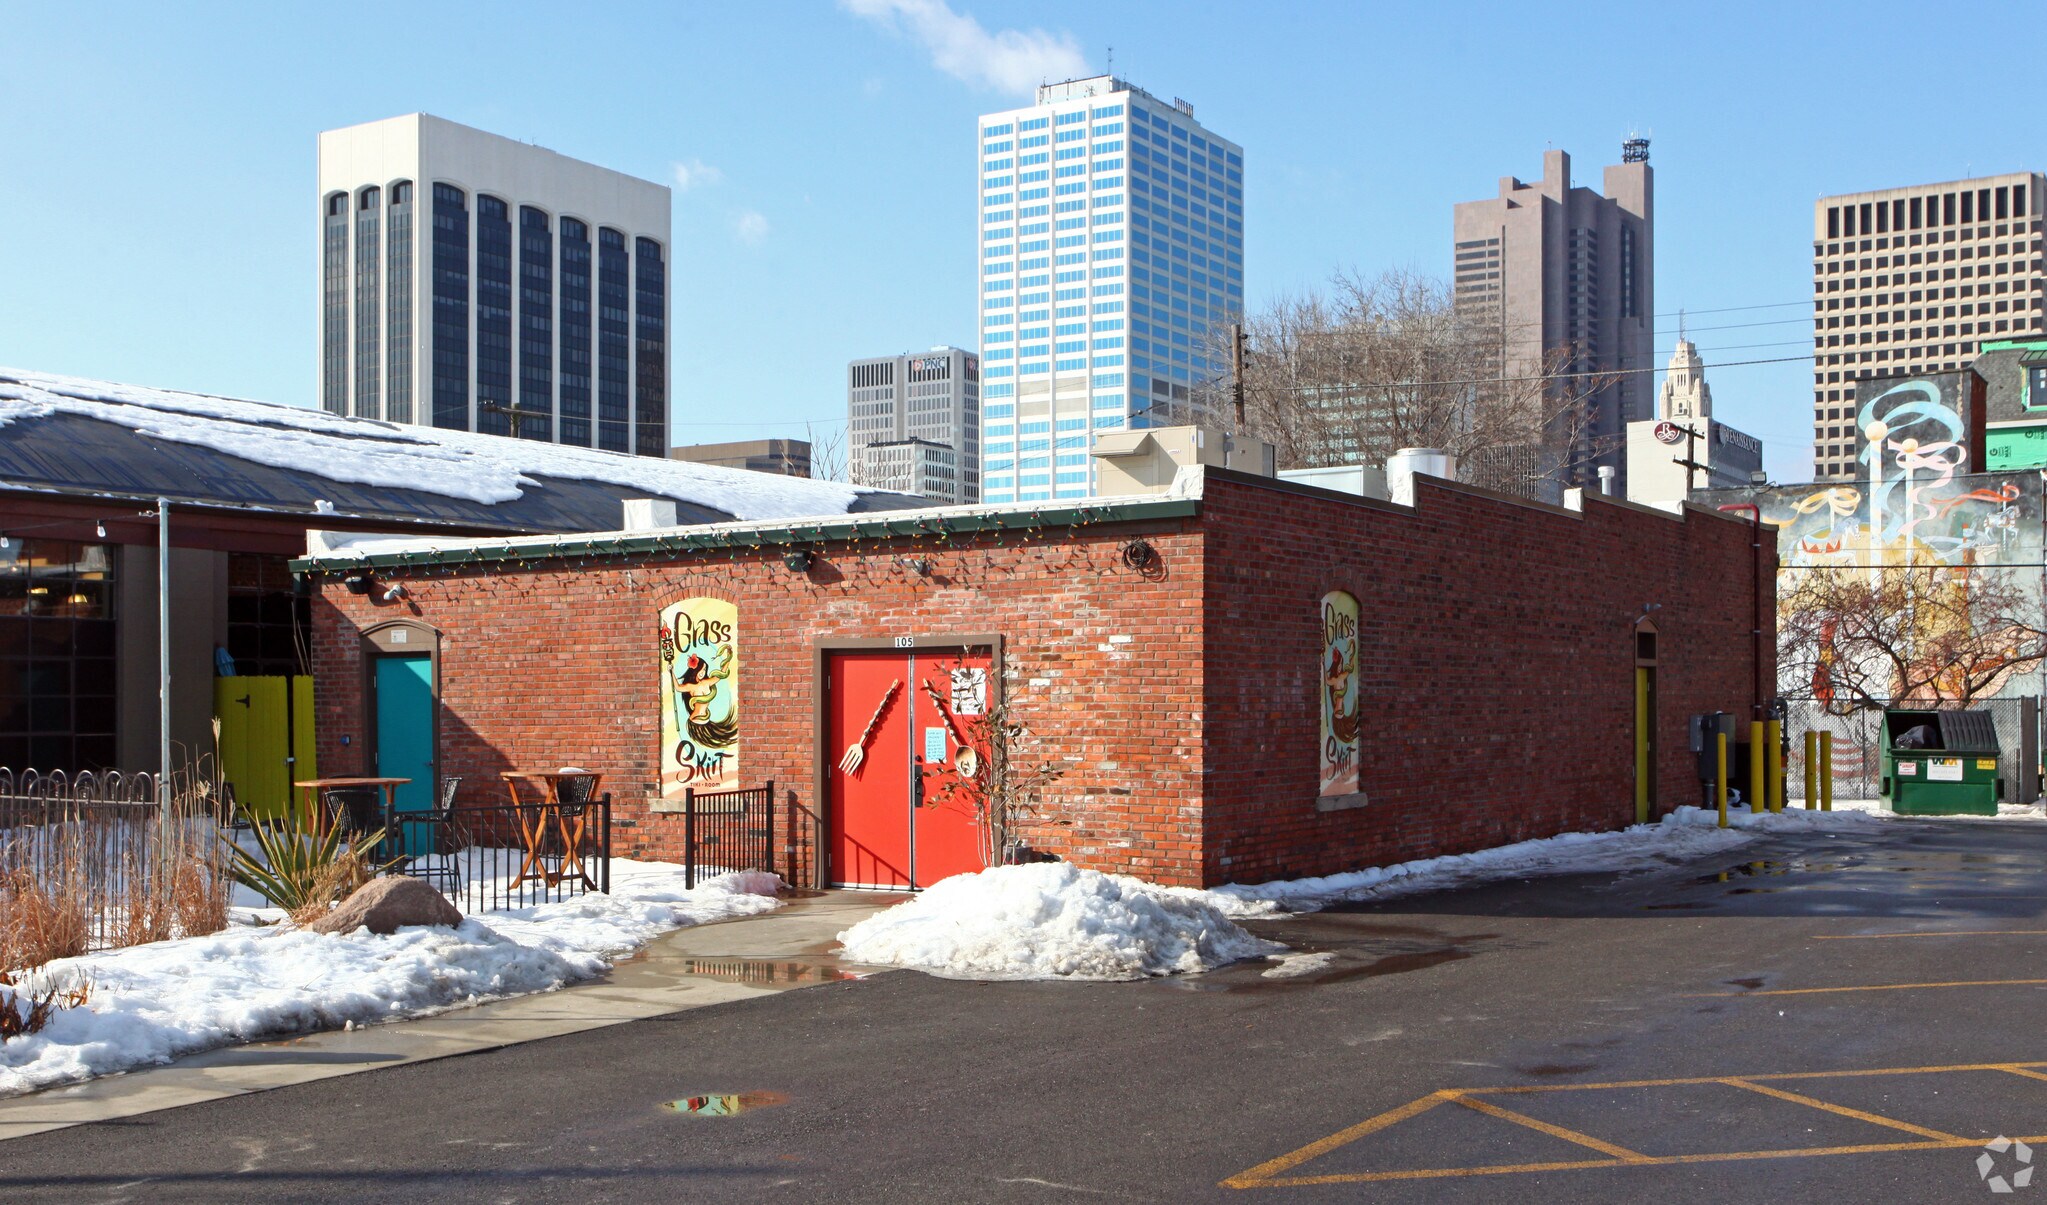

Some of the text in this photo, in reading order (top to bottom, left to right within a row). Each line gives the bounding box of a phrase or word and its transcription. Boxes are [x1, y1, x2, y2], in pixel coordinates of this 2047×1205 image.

[924, 359, 945, 370] PNC
[1725, 428, 1758, 453] RENAISSANCE
[674, 611, 732, 653] Grass
[1325, 602, 1355, 645] Grass
[896, 637, 913, 647] 105
